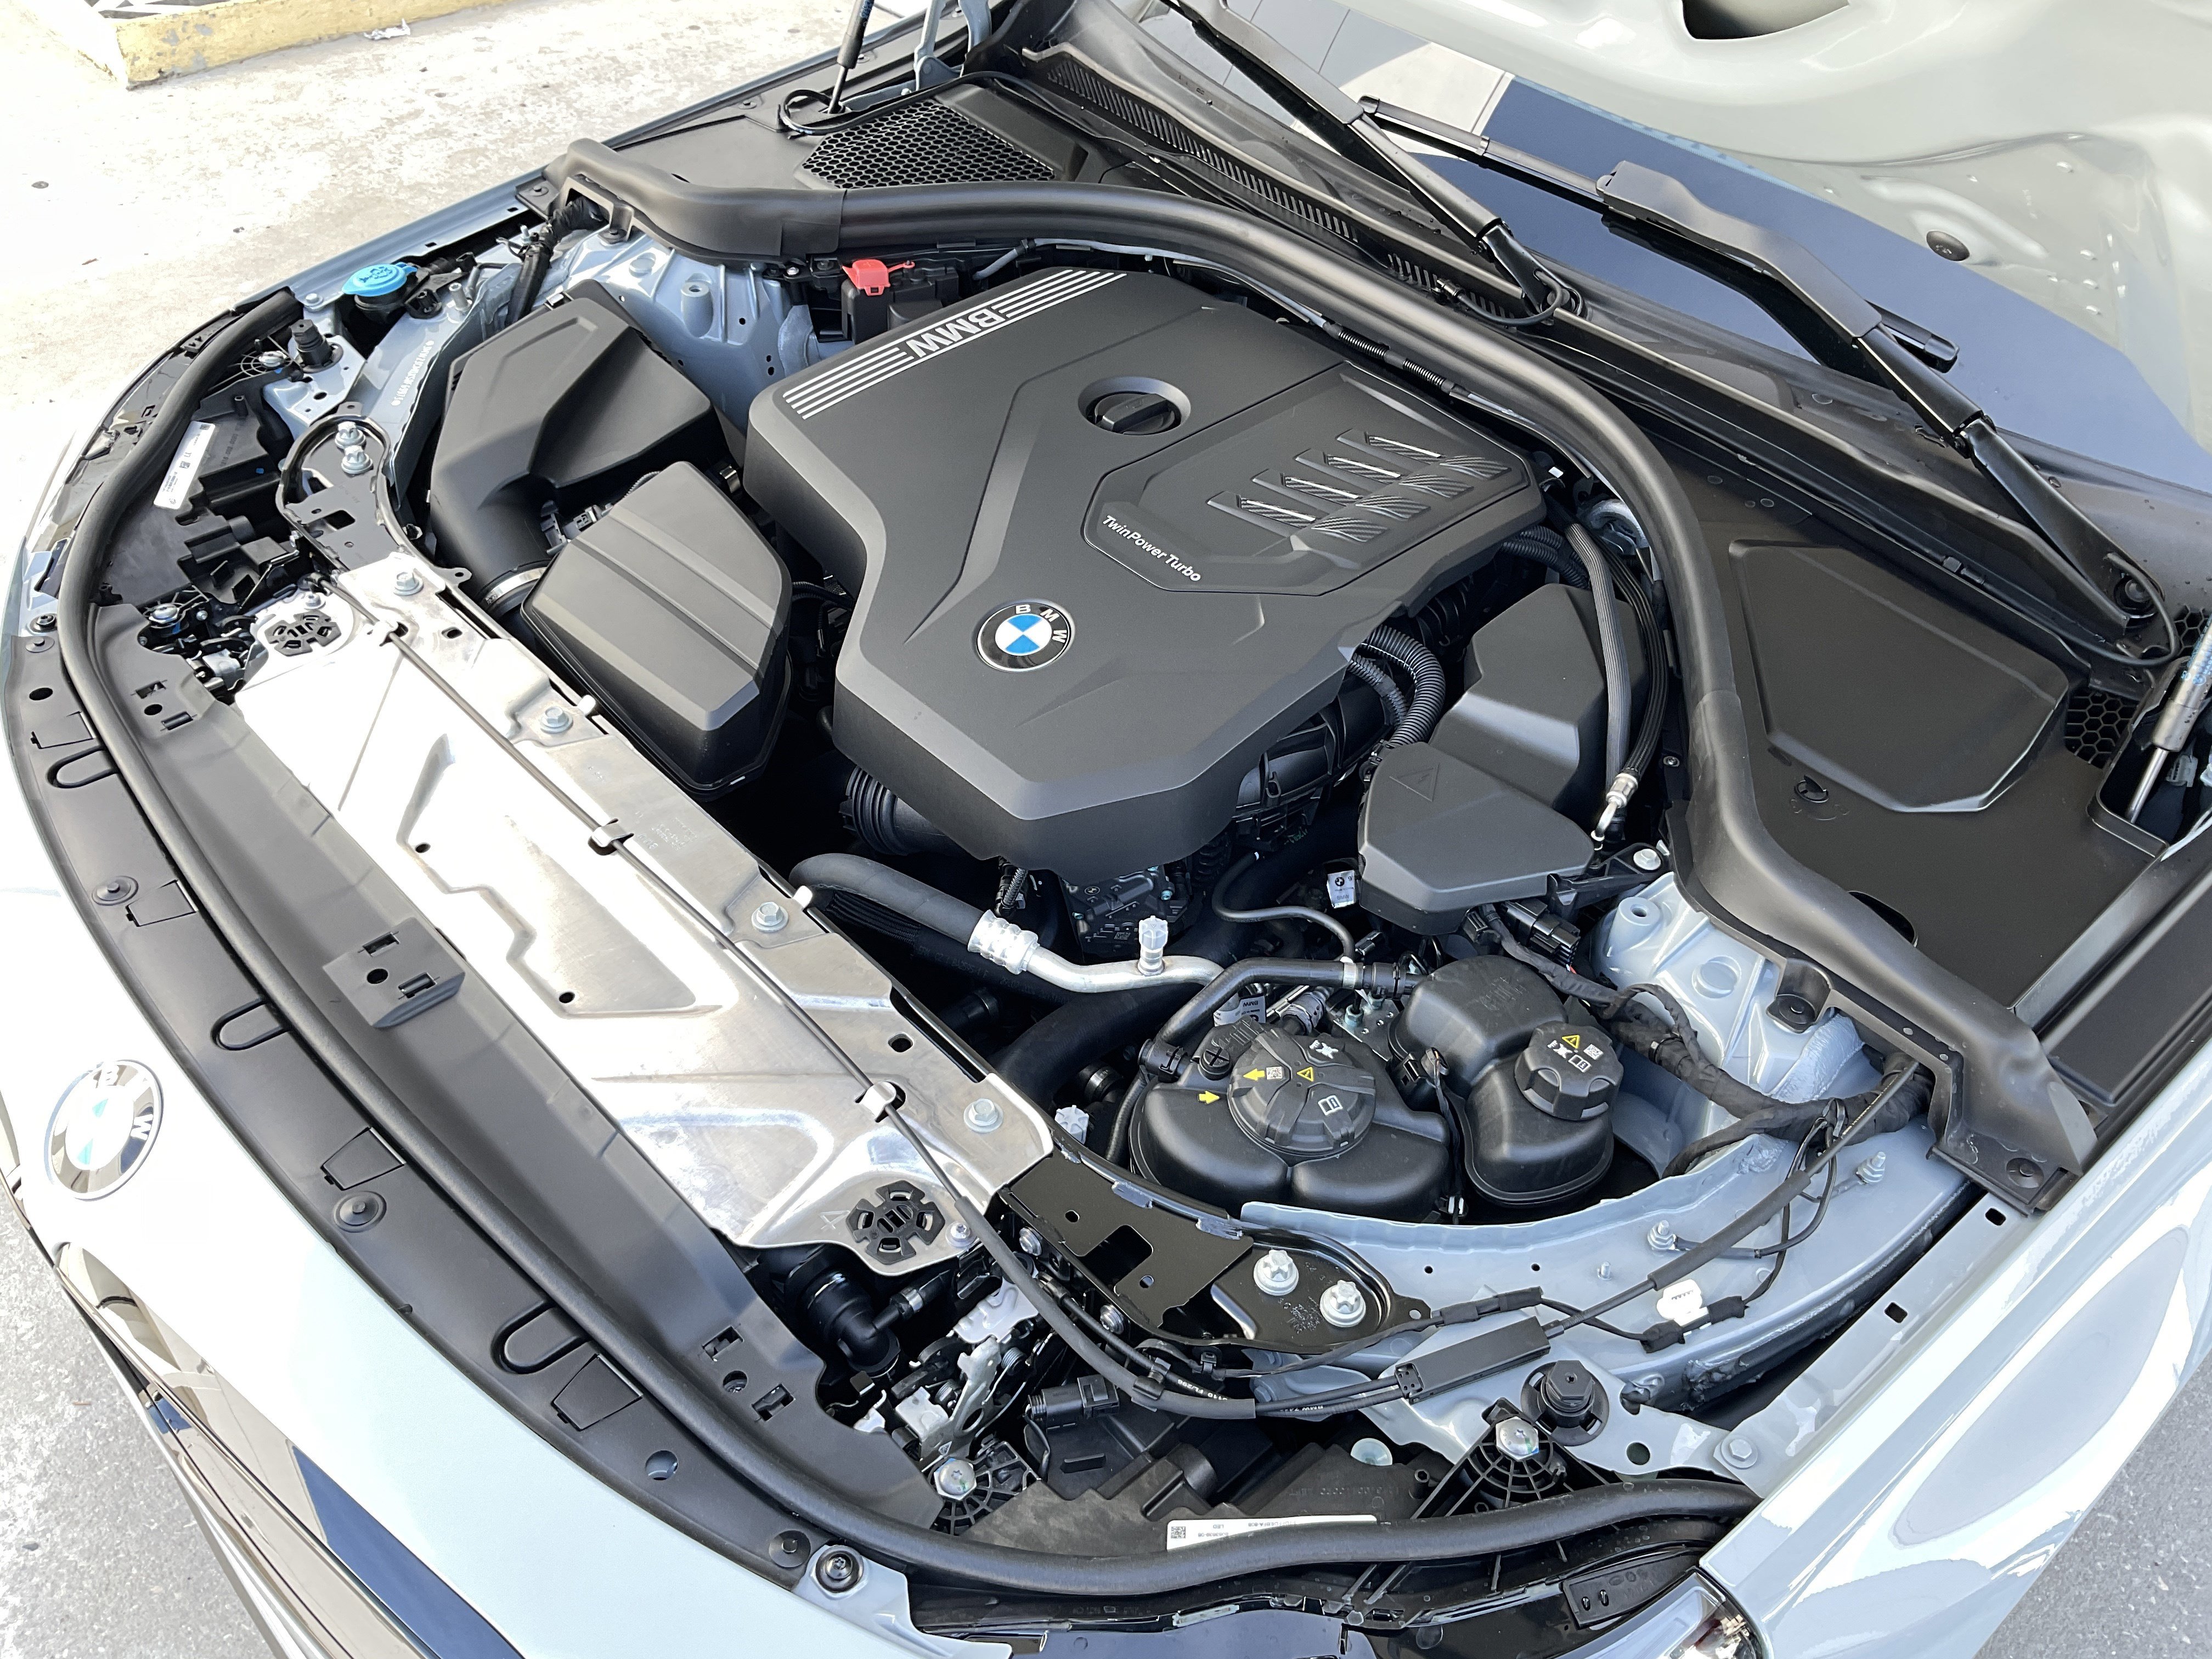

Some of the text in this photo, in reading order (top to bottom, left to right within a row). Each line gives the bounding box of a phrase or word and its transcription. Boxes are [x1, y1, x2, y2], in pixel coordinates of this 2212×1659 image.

[906, 308, 1006, 358] BMW
[1103, 515, 1201, 582] TwinPower Turbo
[1015, 604, 1067, 643] BMW
